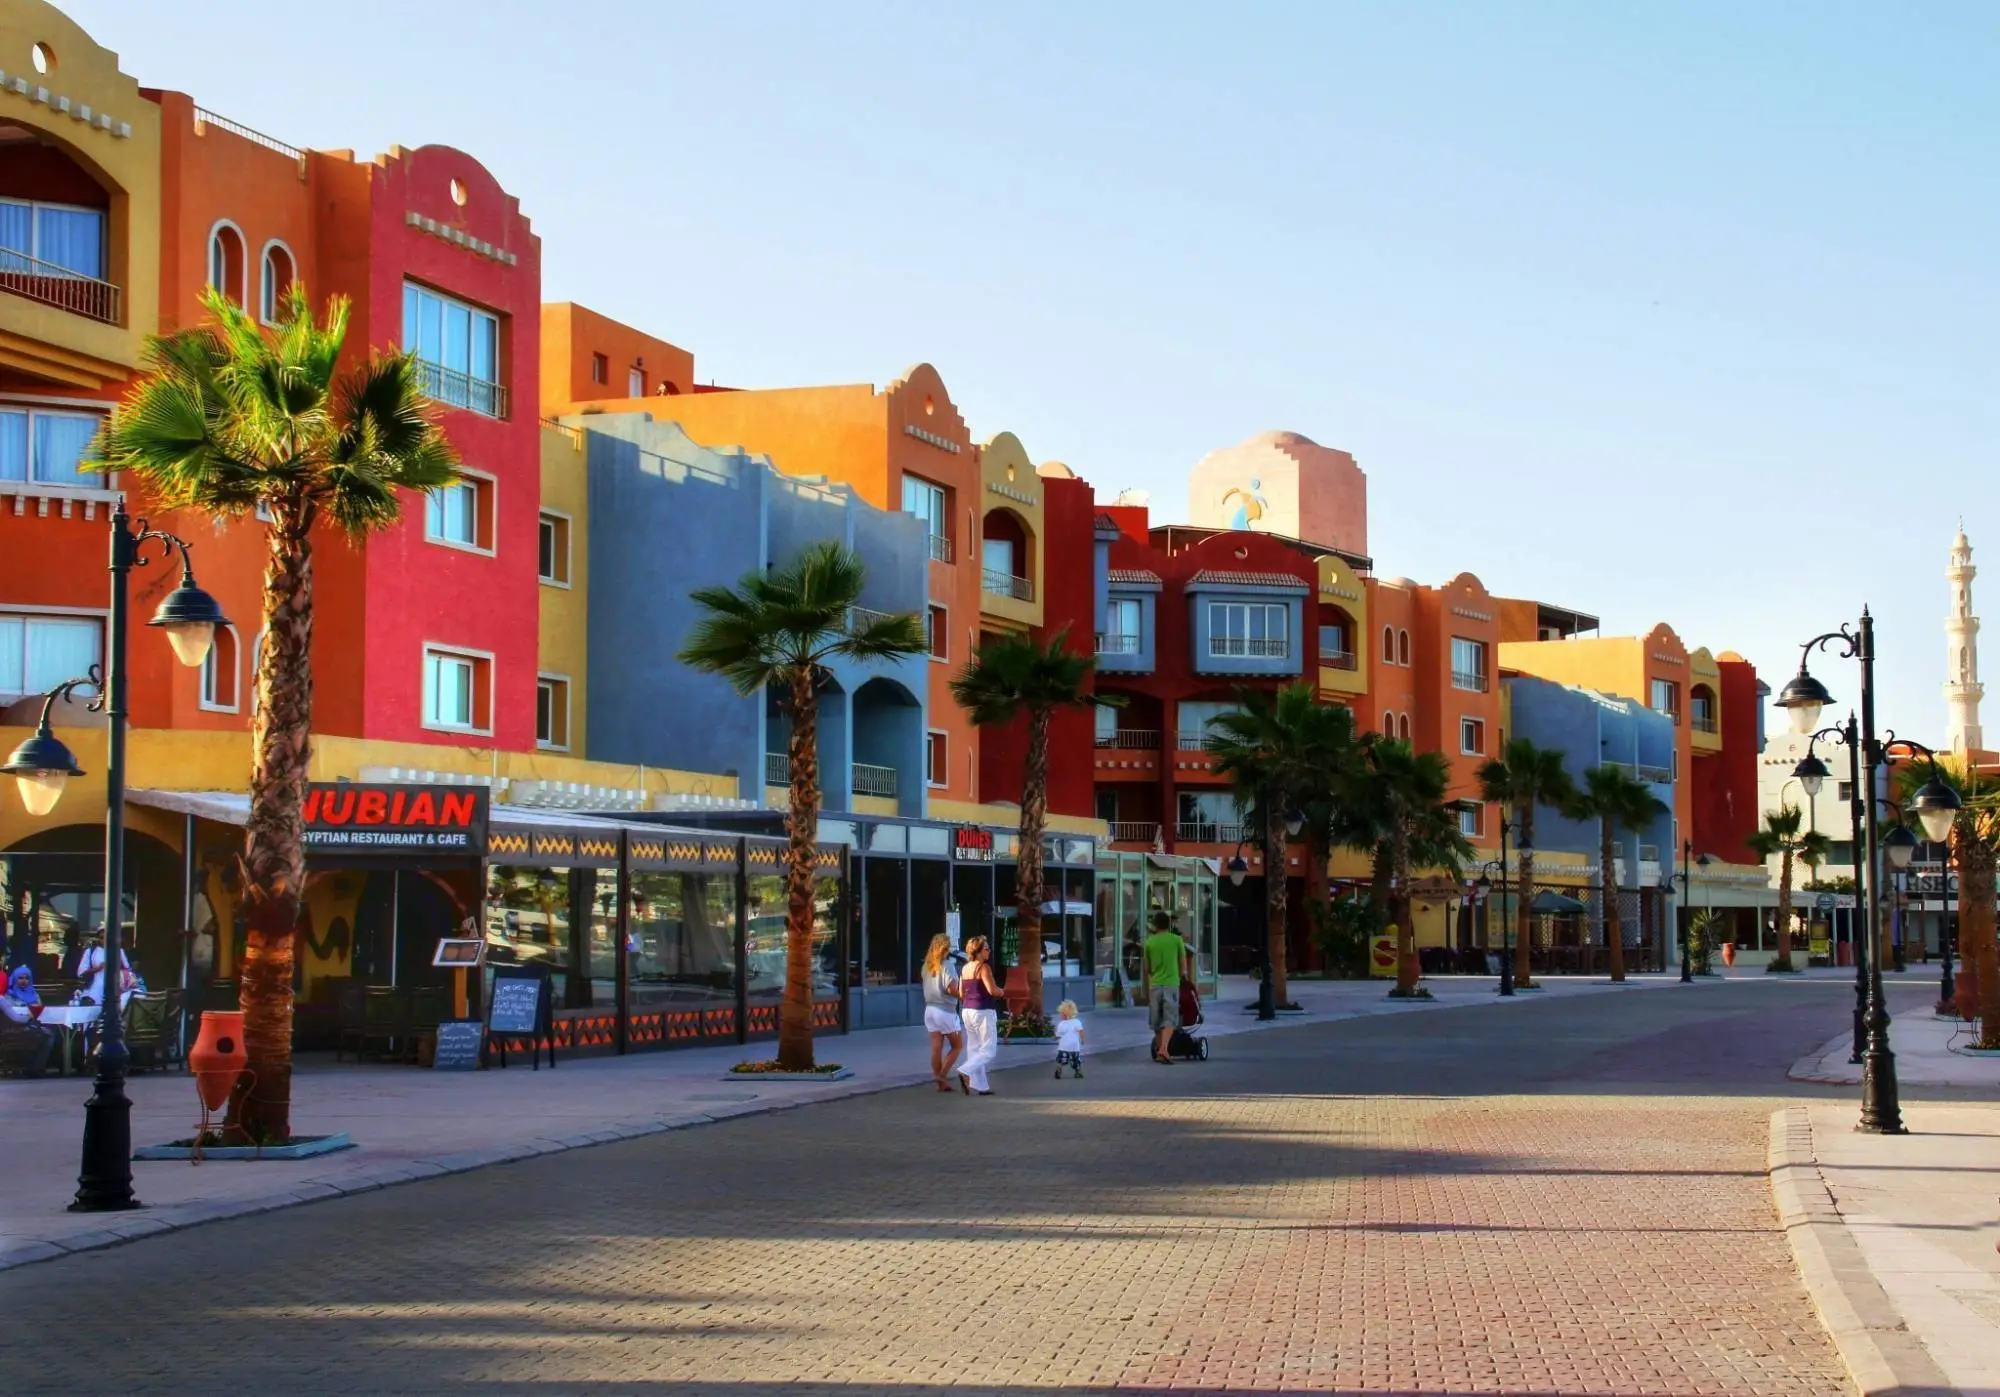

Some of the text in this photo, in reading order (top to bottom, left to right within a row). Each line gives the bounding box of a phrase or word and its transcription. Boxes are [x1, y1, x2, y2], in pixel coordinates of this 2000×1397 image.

[300, 831, 466, 845] GYPTIAN RESTAURANT & CAFE
